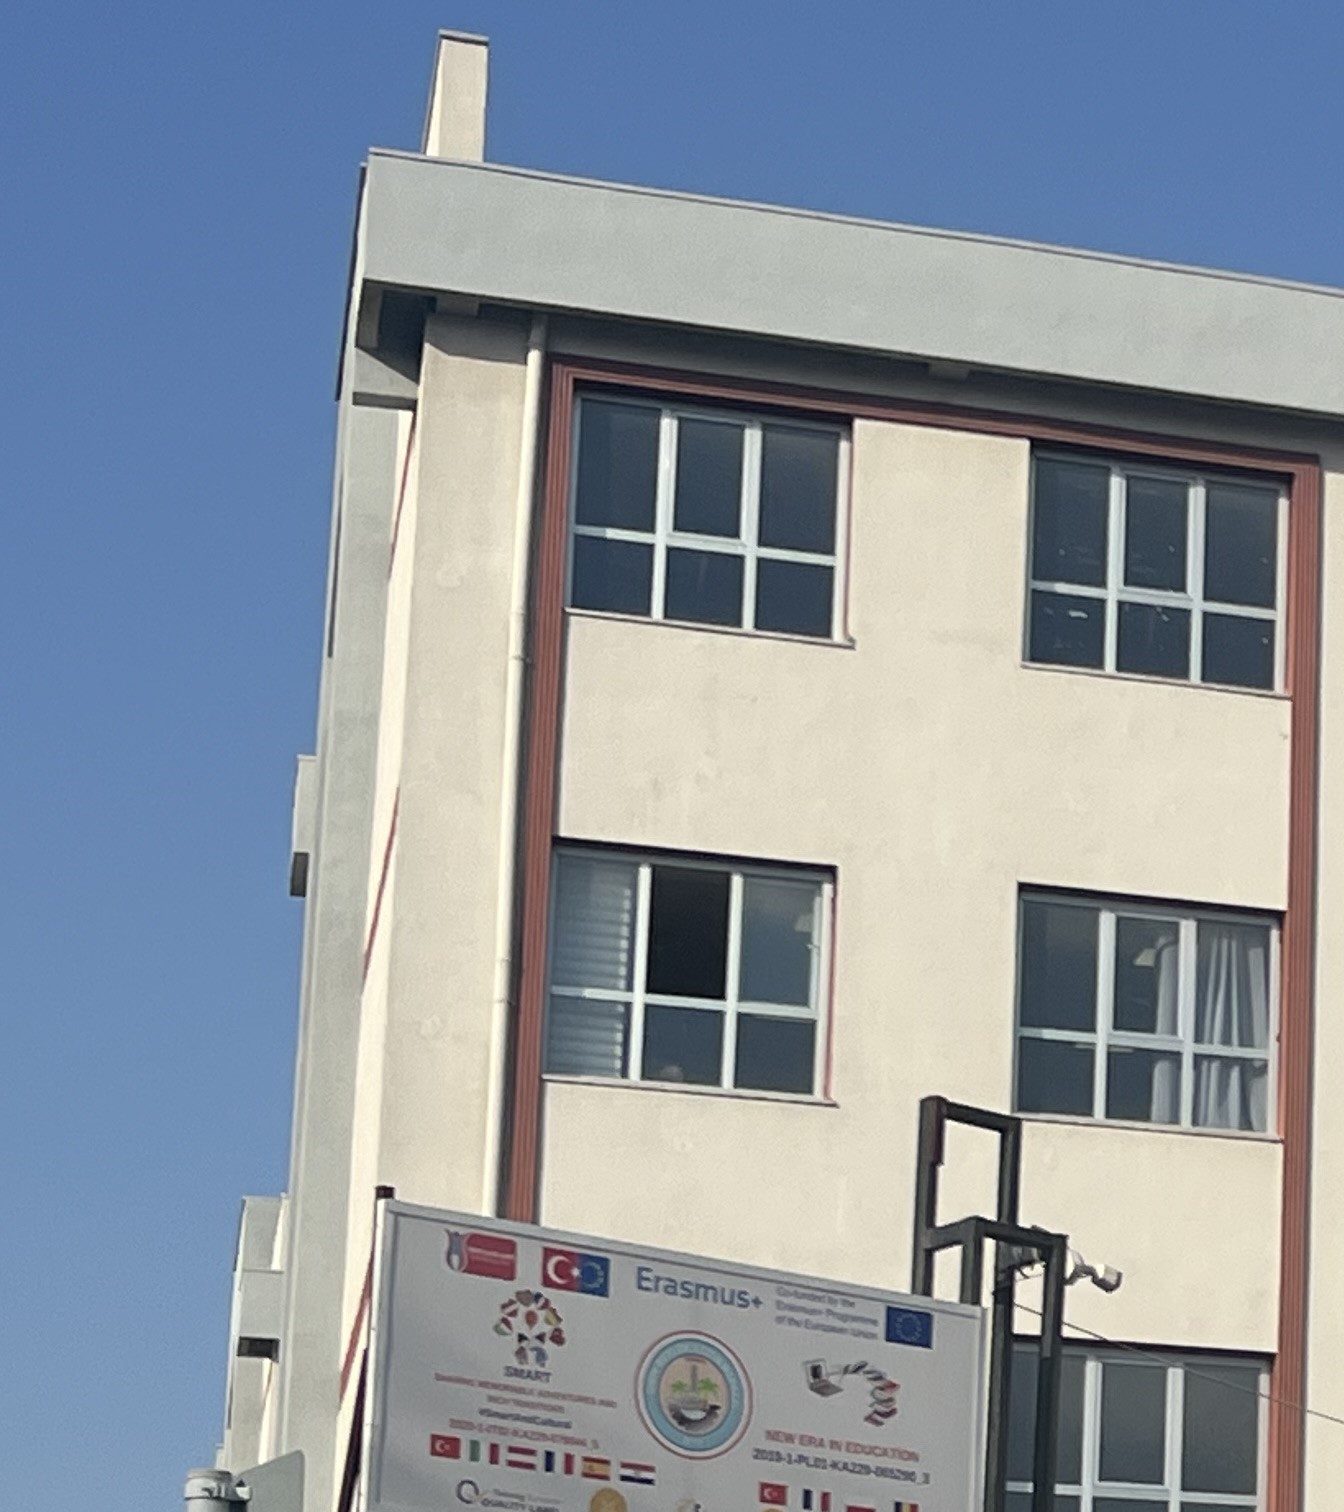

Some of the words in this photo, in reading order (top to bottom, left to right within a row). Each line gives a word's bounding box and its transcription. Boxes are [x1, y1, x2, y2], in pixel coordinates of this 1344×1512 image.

[636, 1266, 763, 1310] Erasmus+
[504, 1365, 551, 1383] SMART
[765, 1429, 795, 1444] NEW
[799, 1434, 826, 1449] ERA
[829, 1438, 843, 1452] IN
[845, 1440, 920, 1462] EDUCATION
